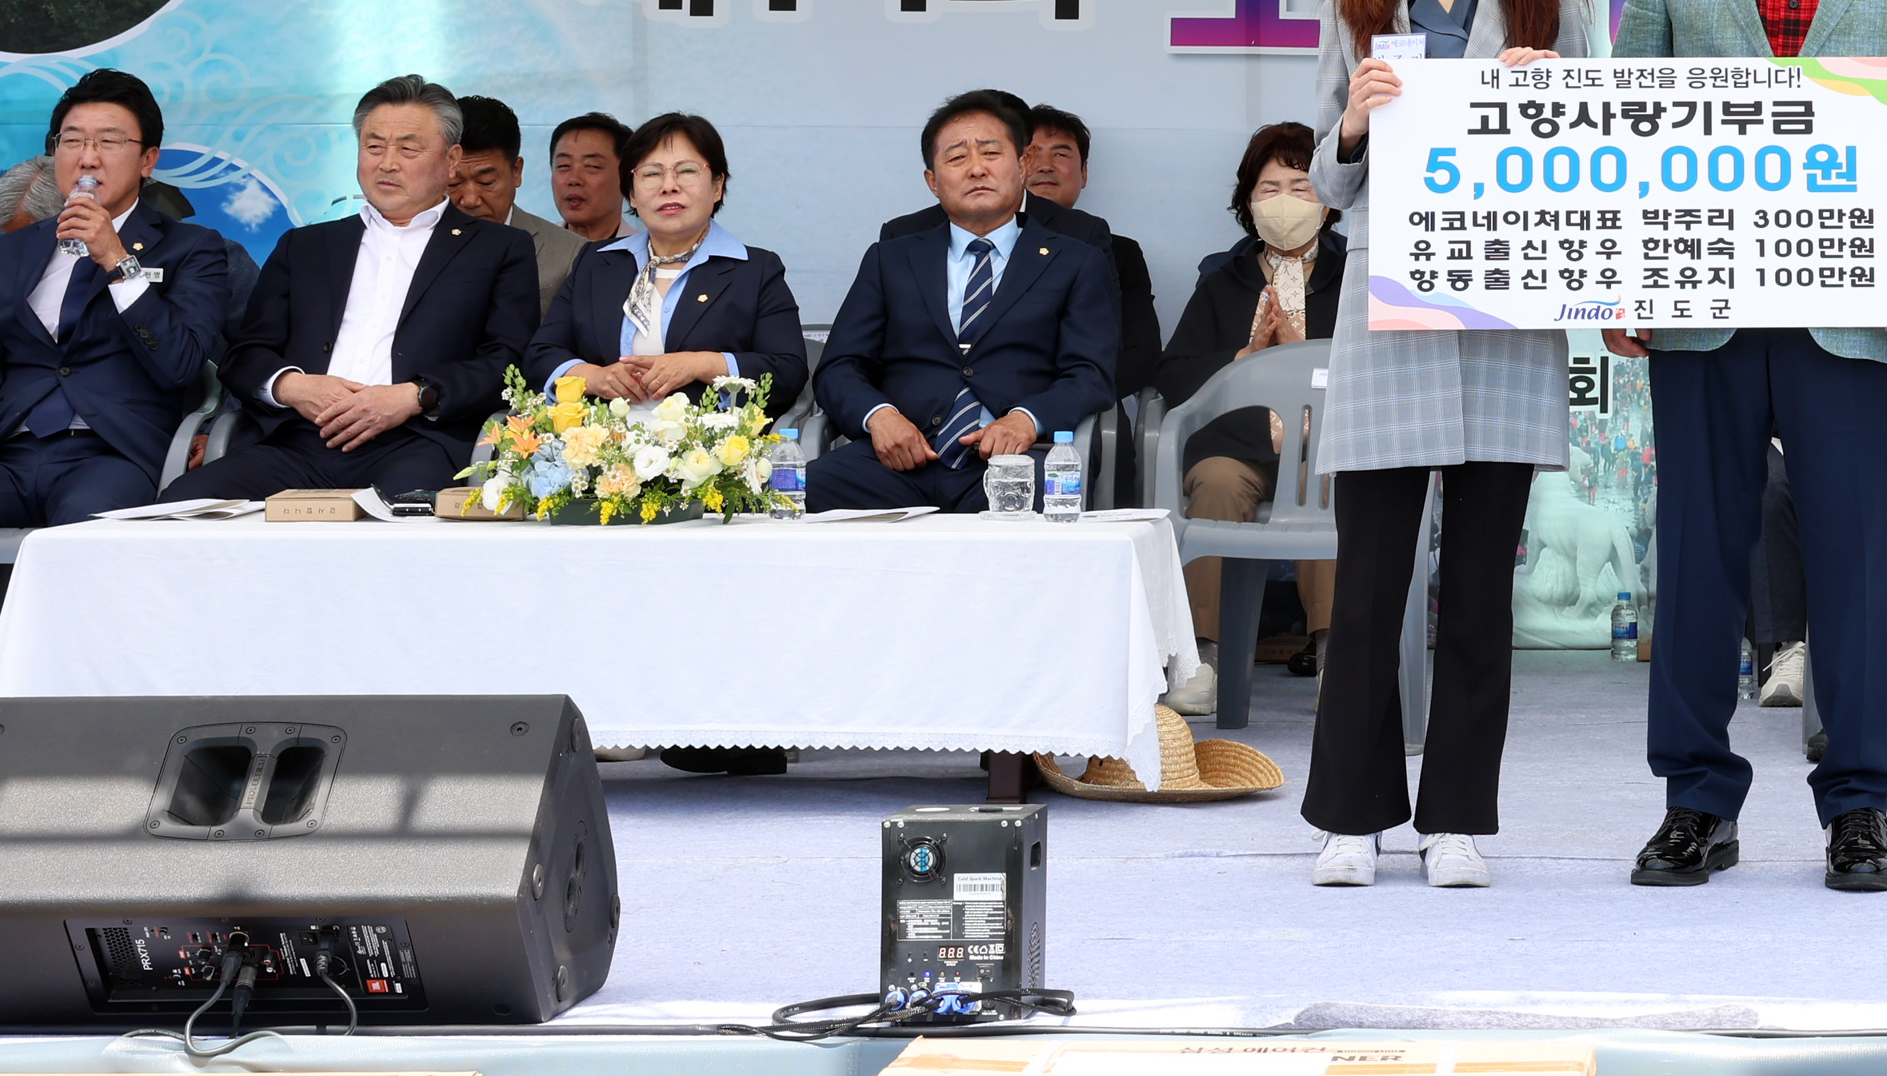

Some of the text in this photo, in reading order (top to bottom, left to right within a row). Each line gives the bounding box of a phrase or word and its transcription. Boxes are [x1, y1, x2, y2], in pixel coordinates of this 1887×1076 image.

[1482, 68, 1800, 89] 내 고향 진도 발전을 응원합니다!
[1468, 100, 1814, 138] 고향사랑기부금
[1424, 144, 1857, 199] 5,000,000원
[1409, 208, 1873, 231] 에코네이쳐대표 박주리 300만원
[1642, 238, 1734, 260] 한혜숙
[1756, 237, 1874, 258] 100만원
[1642, 267, 1734, 289] 조유지
[1756, 267, 1874, 287] 100만원
[1555, 303, 1614, 322] Jindo
[135, 938, 153, 971] PRX715
